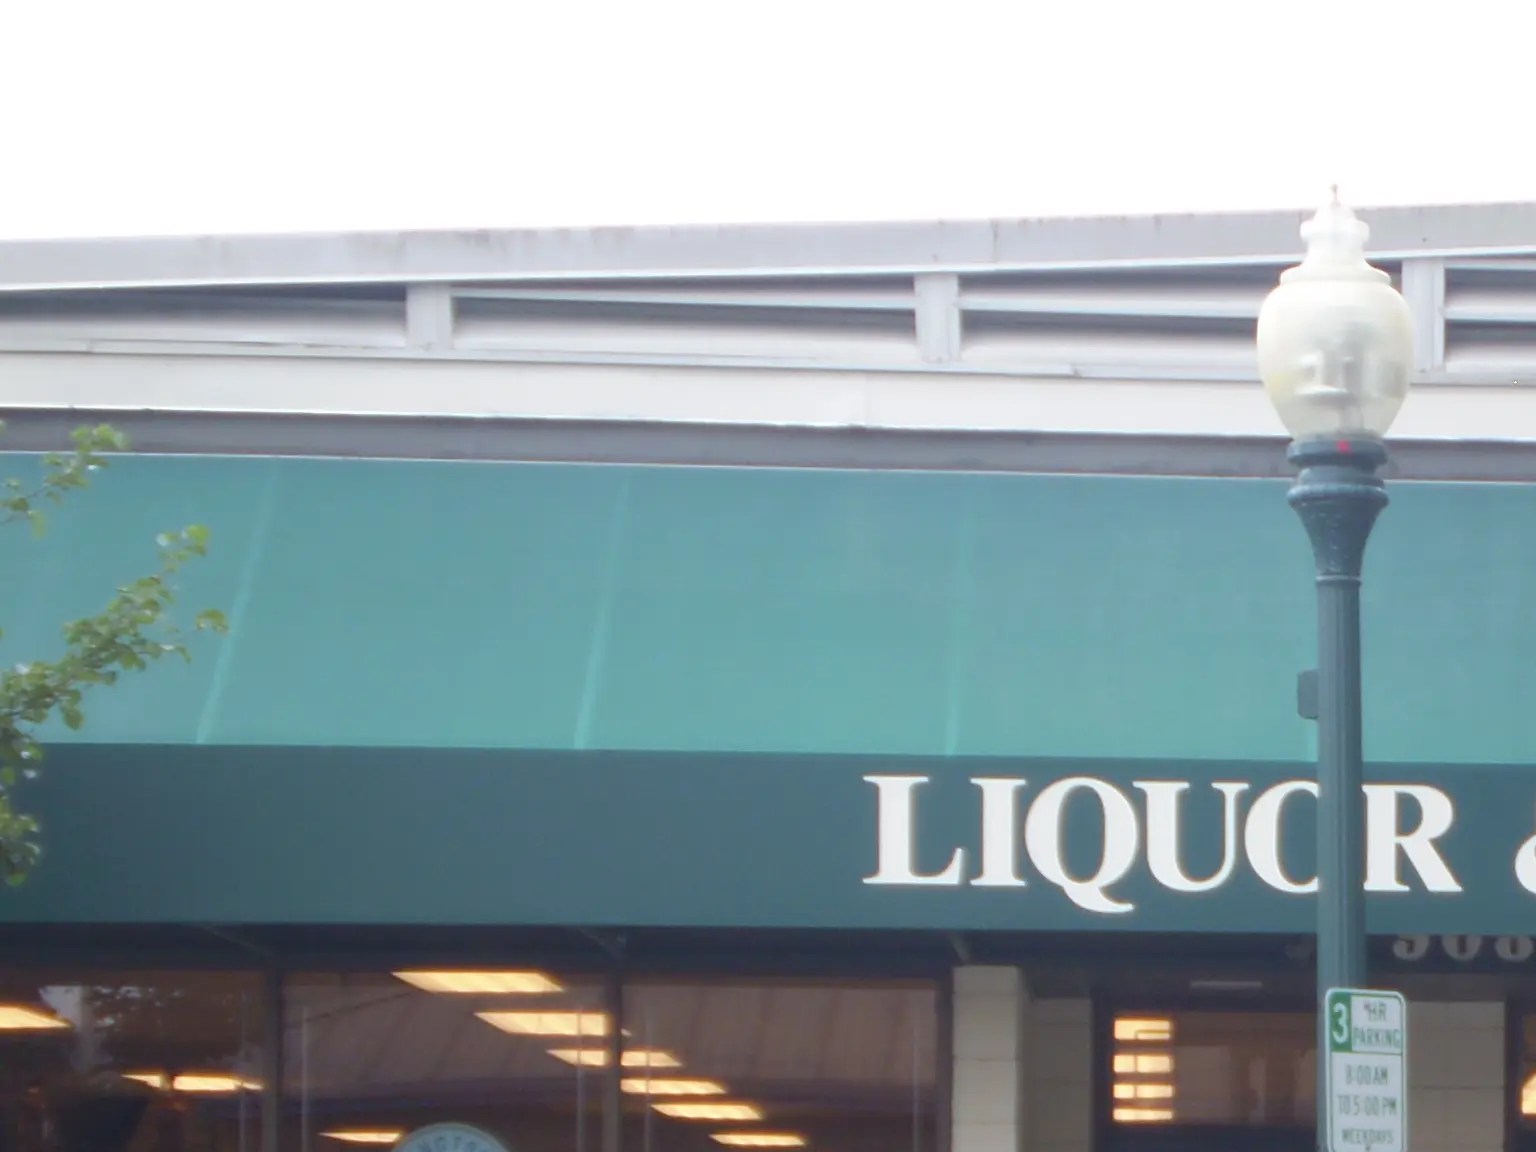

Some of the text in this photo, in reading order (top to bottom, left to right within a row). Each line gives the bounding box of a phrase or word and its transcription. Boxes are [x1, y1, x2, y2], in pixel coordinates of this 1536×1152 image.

[862, 775, 1464, 912] LIQUOR
[1332, 1002, 1387, 1044] 3 HR
[1353, 1026, 1401, 1050] PARKING
[1342, 1128, 1394, 1145] WEEKDAYS
